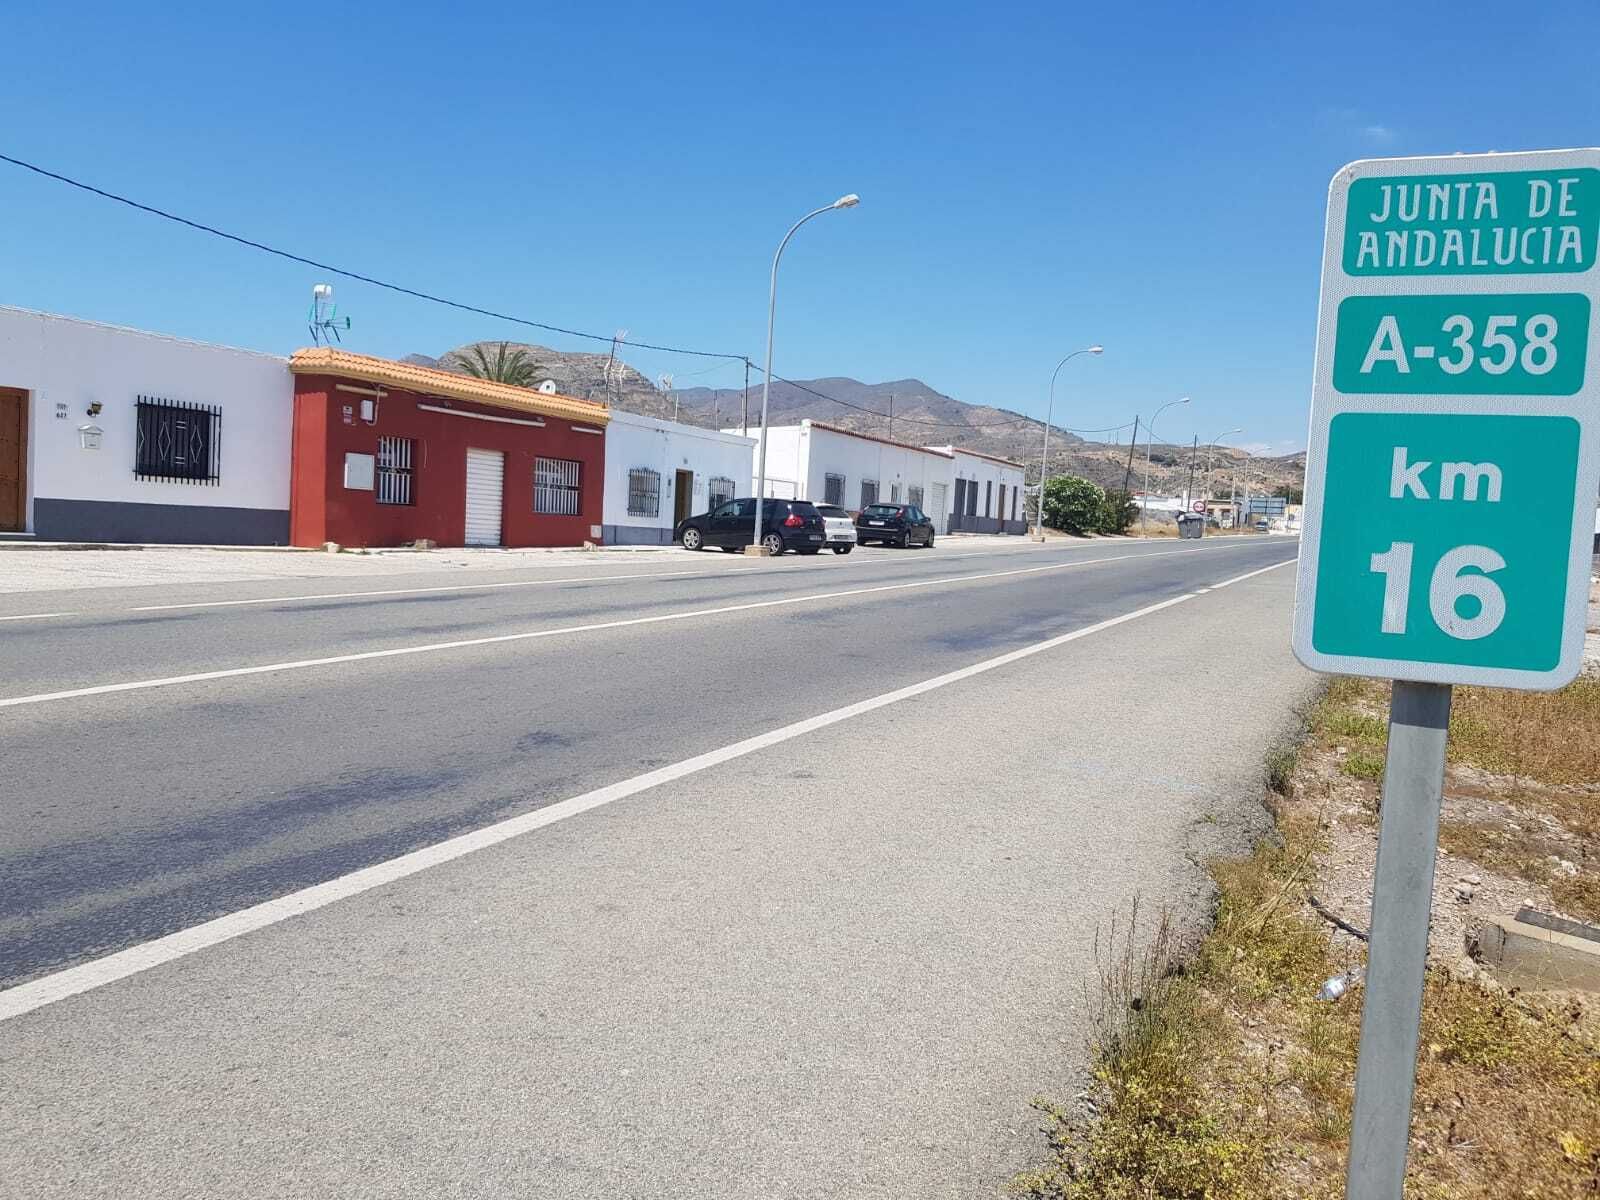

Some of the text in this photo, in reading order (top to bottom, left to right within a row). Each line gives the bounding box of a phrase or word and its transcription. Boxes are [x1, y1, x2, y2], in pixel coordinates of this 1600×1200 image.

[1370, 179, 1580, 223] JUNTA DE
[1356, 227, 1583, 268] ANDALUCIA
[1360, 314, 1558, 375] A-358
[1390, 446, 1503, 502] km
[1370, 541, 1506, 640] 16
